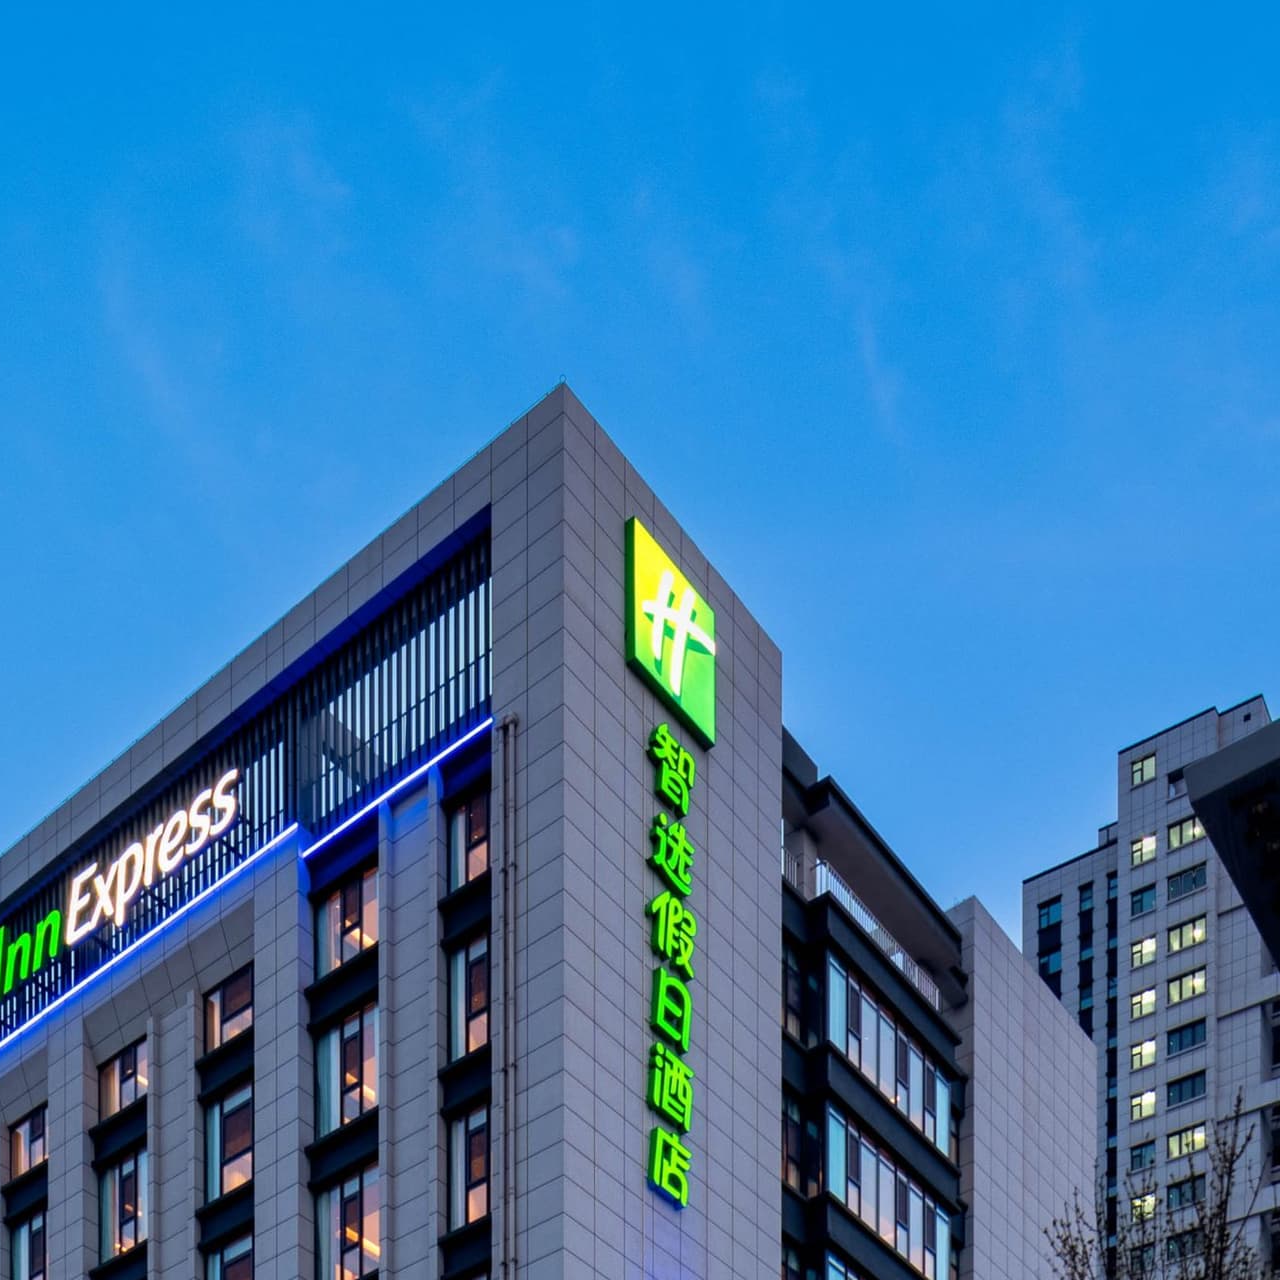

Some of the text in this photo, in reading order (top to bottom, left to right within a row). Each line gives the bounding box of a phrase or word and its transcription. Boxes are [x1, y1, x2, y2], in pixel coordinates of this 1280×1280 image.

[65, 767, 239, 946] Express
[648, 722, 696, 1209] 智选假日酒店
